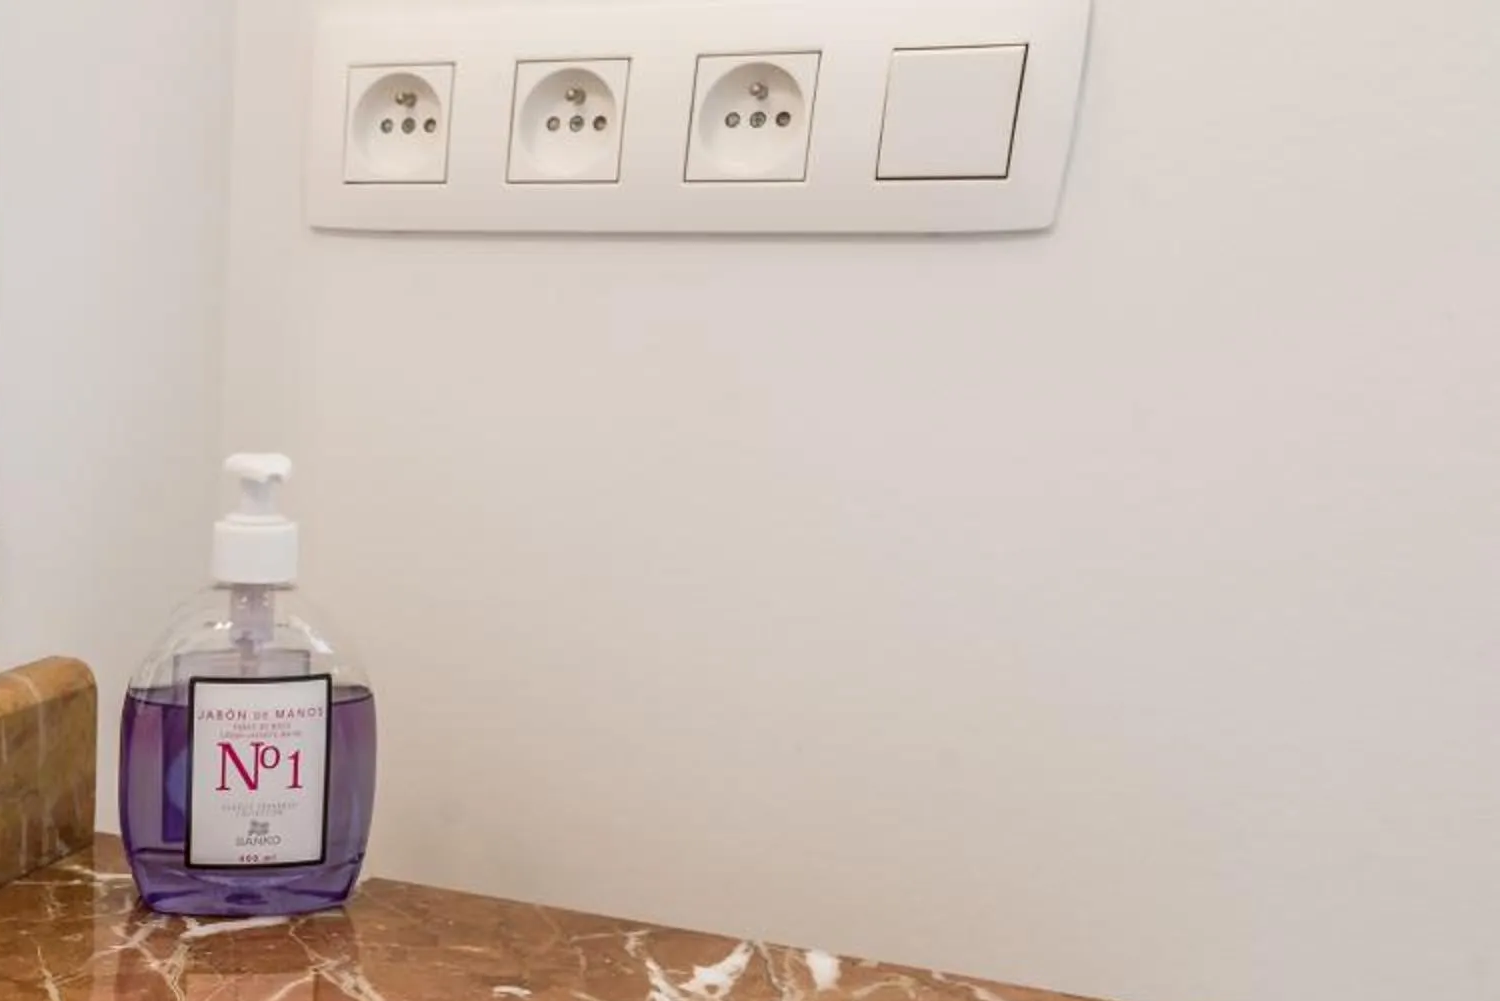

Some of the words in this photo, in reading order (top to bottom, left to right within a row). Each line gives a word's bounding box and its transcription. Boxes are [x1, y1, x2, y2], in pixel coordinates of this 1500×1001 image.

[198, 709, 247, 721] JABÓN
[275, 707, 324, 719] MANOS
[286, 750, 303, 789] 1
